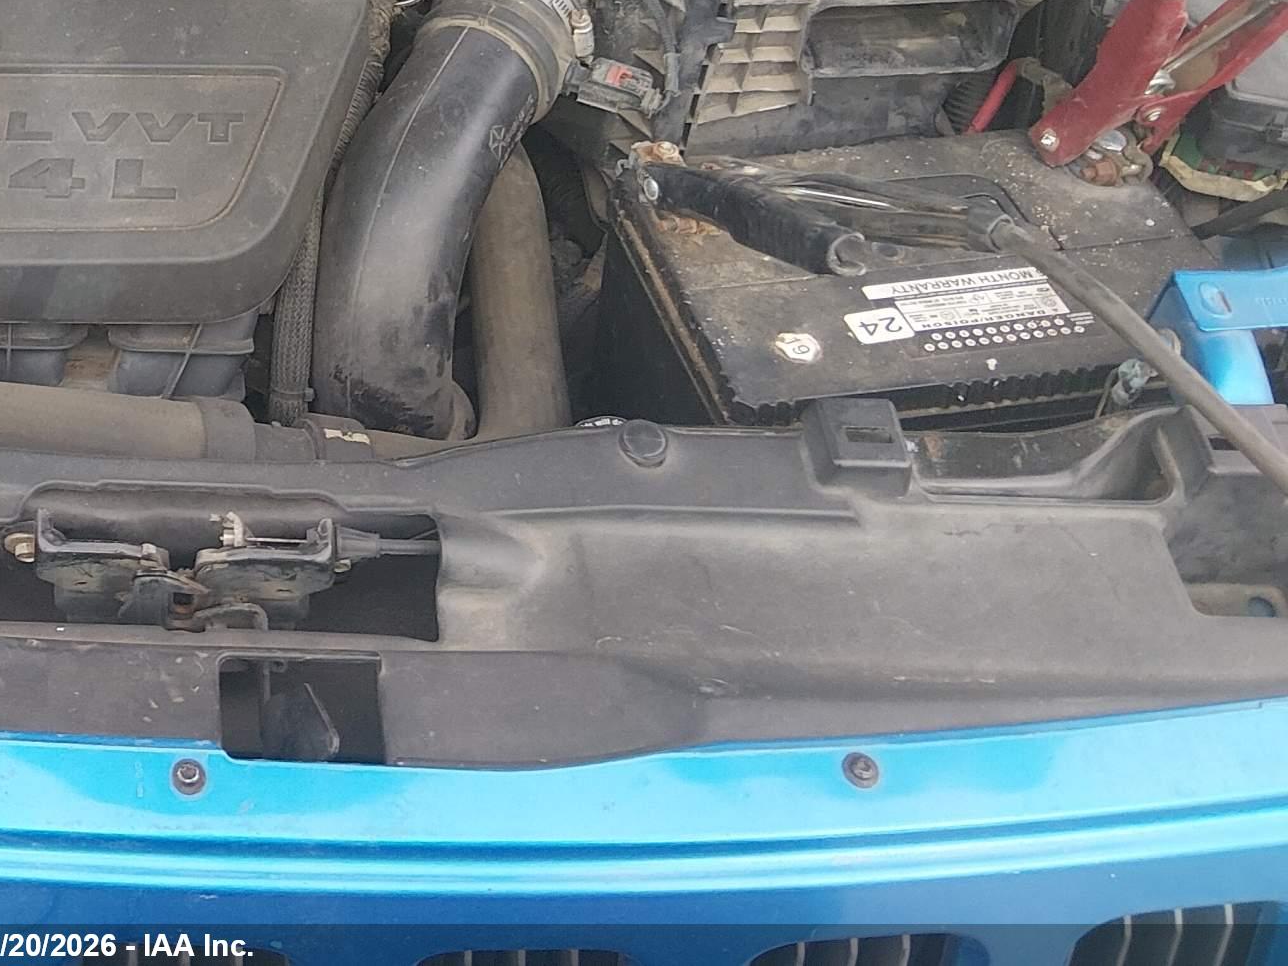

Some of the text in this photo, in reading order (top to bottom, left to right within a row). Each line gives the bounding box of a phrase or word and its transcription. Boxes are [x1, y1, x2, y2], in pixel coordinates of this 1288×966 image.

[71, 110, 245, 144] VVT
[890, 274, 974, 295] WARRANTY
[977, 269, 1034, 285] MONTH
[859, 316, 903, 338] 24
